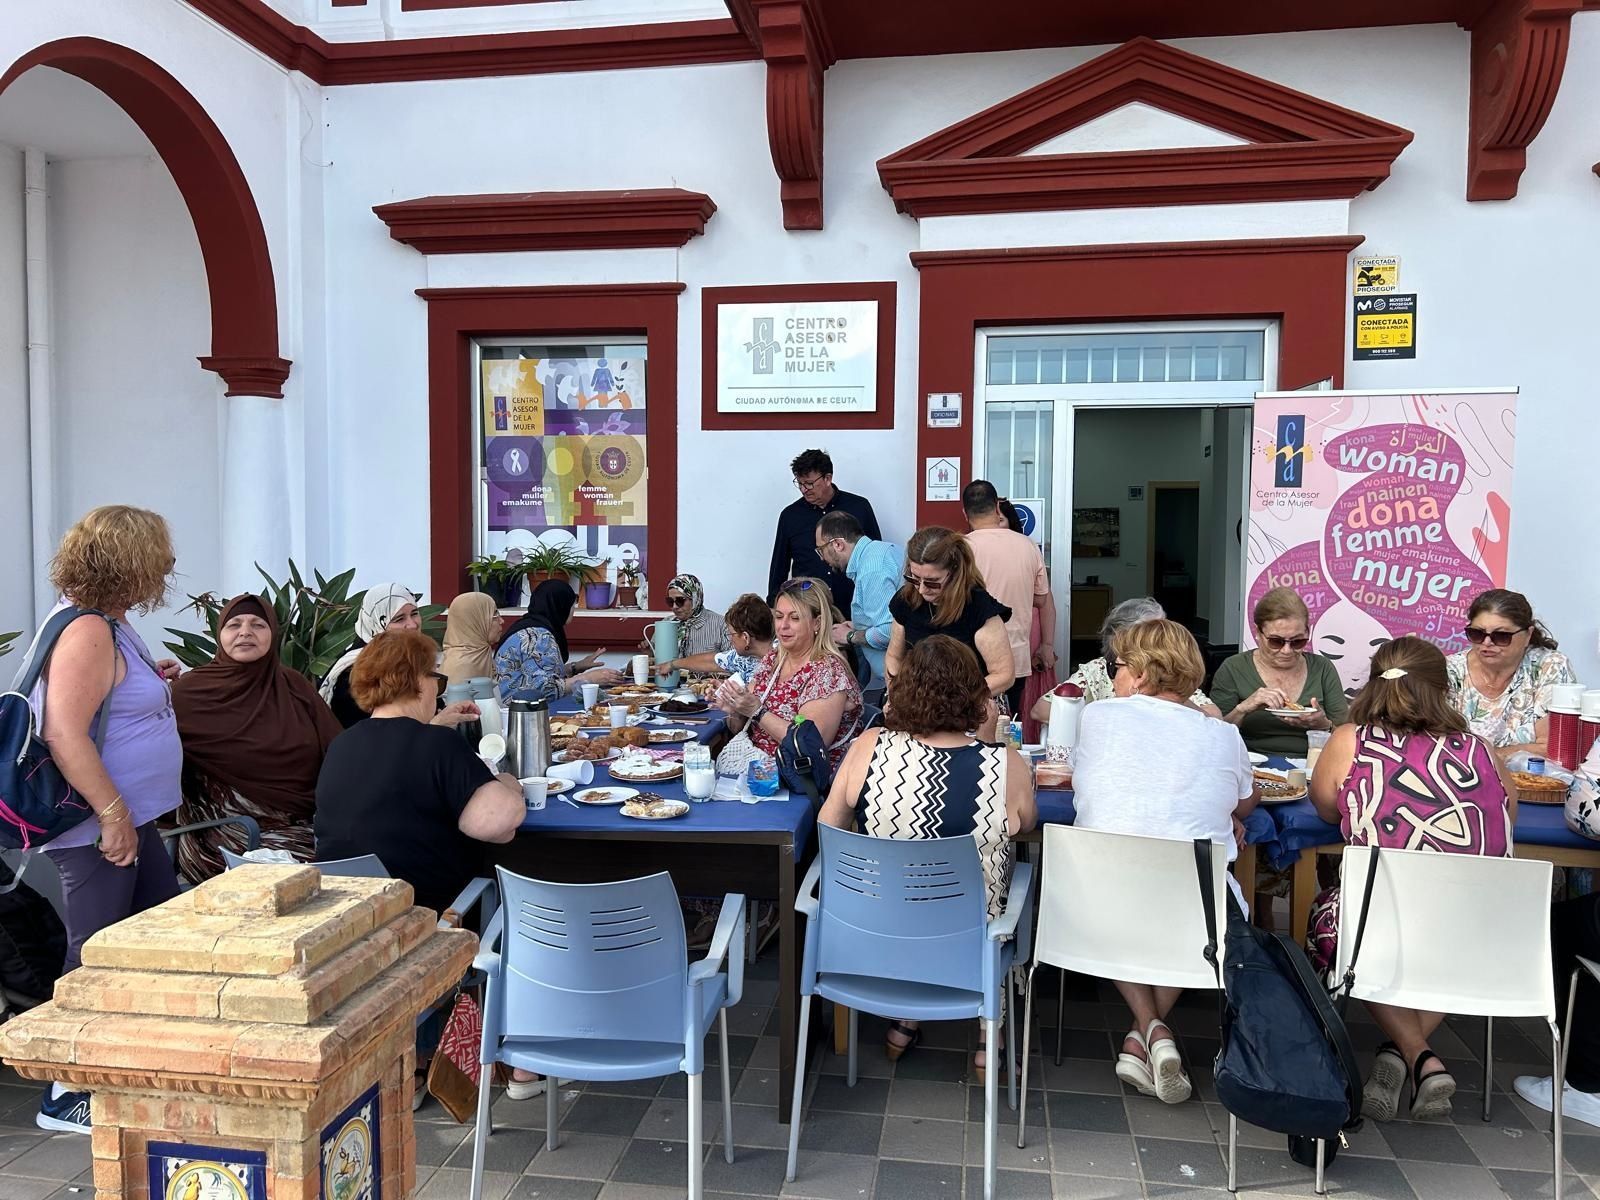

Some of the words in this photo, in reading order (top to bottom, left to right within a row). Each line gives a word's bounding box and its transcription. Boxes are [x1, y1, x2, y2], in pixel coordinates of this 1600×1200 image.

[785, 317, 847, 330] CENTRO
[785, 332, 847, 344] ASESOR
[785, 347, 805, 358] DE
[810, 347, 829, 358] LA
[785, 361, 836, 373] MUJER
[768, 396, 814, 405] AUTÓNOMA
[1345, 433, 1376, 446] kona
[1407, 432, 1437, 443] muller
[1339, 443, 1460, 485] woman
[1362, 475, 1405, 489] woman
[1256, 490, 1288, 498] Centro
[1290, 491, 1320, 499] Asesor
[1366, 483, 1428, 503] nainen
[1288, 500, 1314, 508] Mujer
[1340, 500, 1357, 509] frau
[1347, 495, 1441, 529] dona
[1331, 522, 1443, 558] femme
[1373, 549, 1400, 561] mujer
[1402, 548, 1461, 566] emakume
[1277, 560, 1319, 573] kvinna
[1439, 566, 1480, 579] emakume
[1267, 569, 1321, 590] kona
[1351, 556, 1473, 606] mujer
[1351, 585, 1400, 610] dona
[1415, 603, 1443, 614] dona
[1389, 615, 1424, 628] woman
